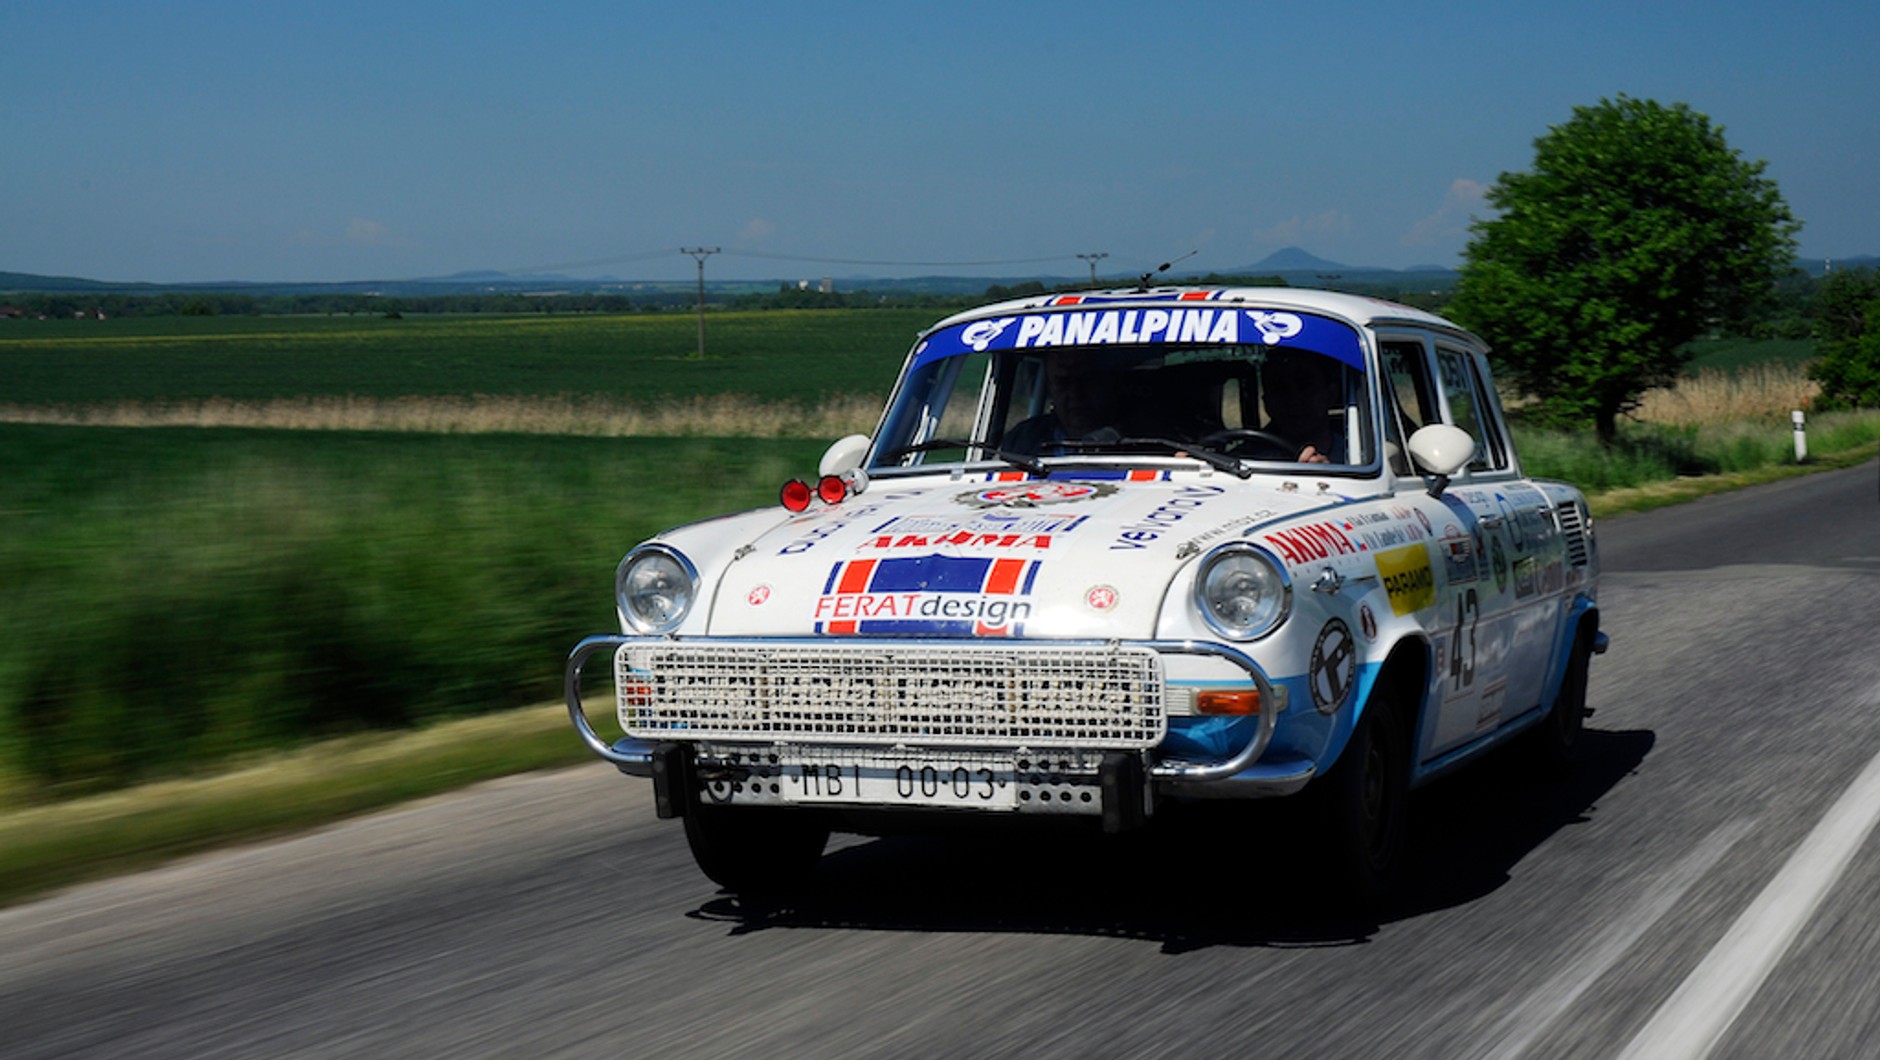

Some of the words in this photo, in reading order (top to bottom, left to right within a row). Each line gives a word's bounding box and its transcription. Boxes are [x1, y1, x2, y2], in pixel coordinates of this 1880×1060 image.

[1014, 309, 1239, 348] PANALPINA
[1263, 521, 1357, 568] AKUMA
[1382, 566, 1433, 599] PARAMO
[1450, 588, 1479, 691] 43
